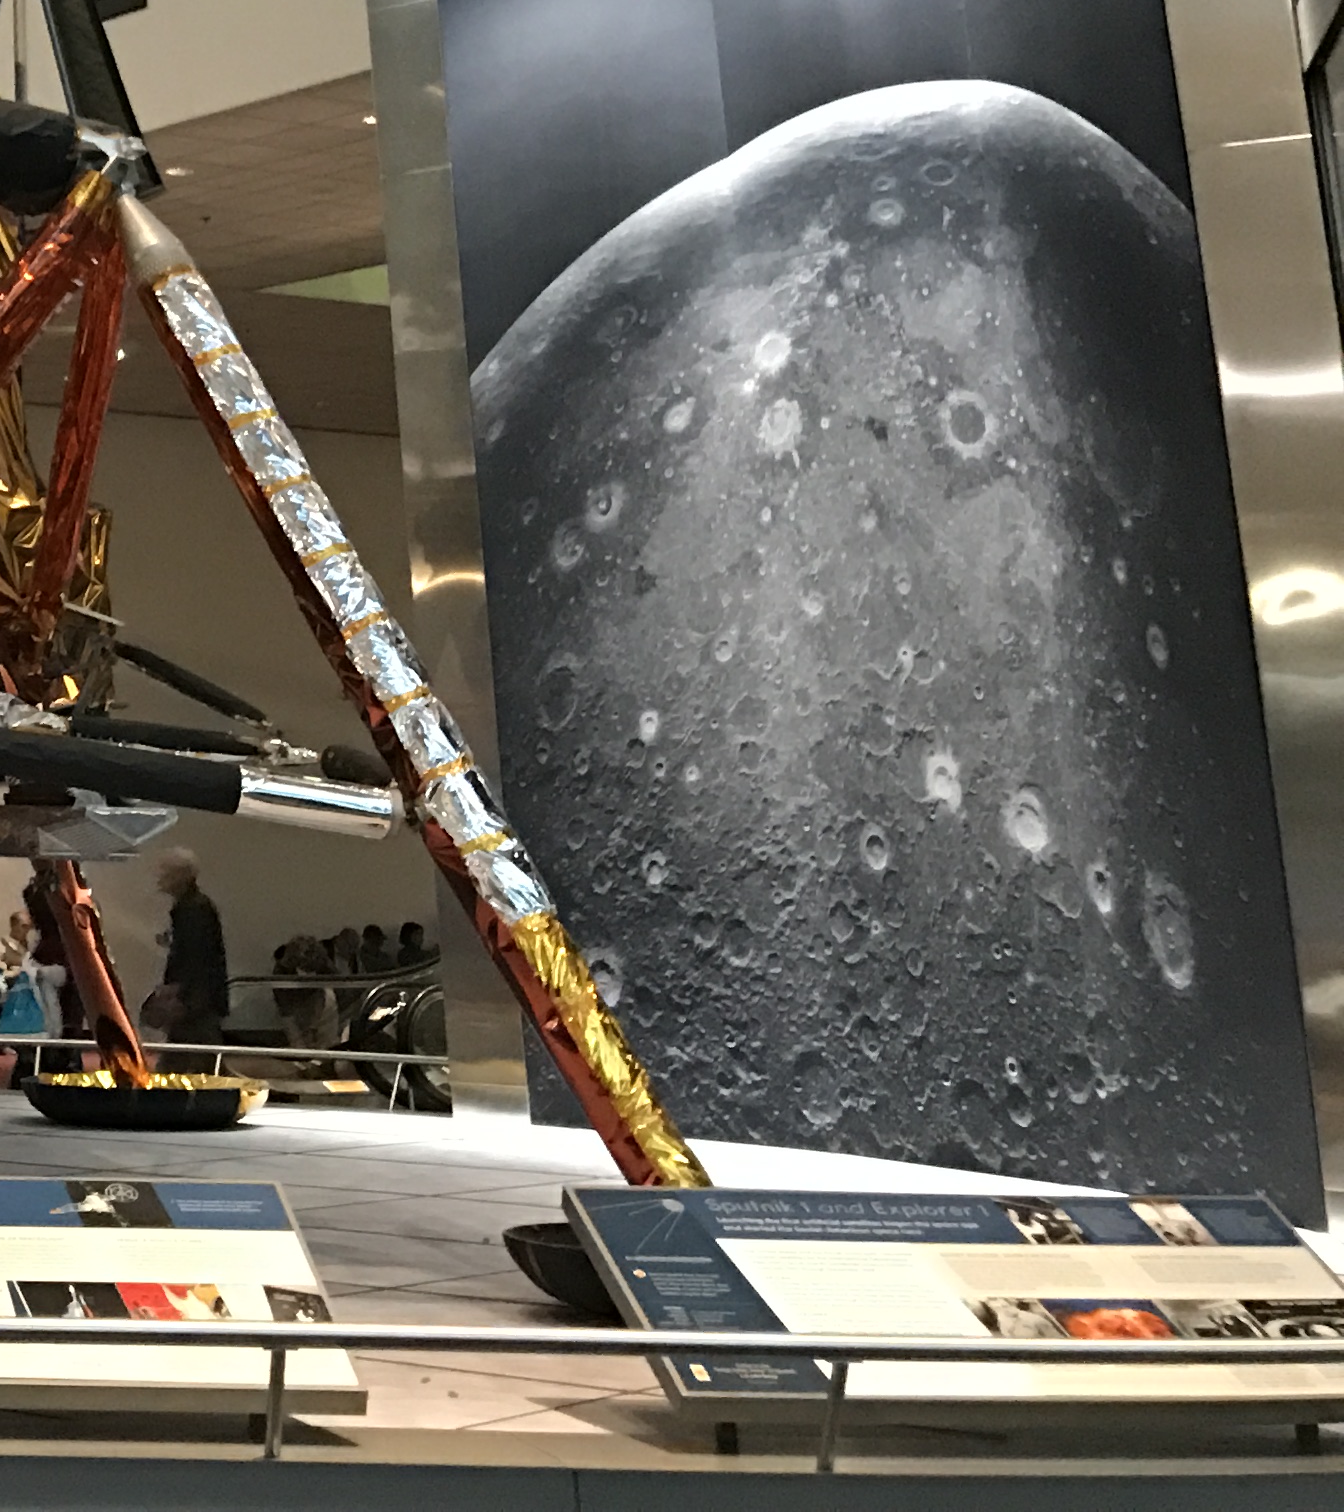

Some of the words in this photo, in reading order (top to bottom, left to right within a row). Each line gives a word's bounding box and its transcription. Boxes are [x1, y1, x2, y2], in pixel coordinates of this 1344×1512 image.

[704, 1198, 794, 1214] Sputnik
[801, 1201, 812, 1213] 1
[818, 1202, 863, 1214] and
[872, 1200, 972, 1218] Explorer
[977, 1204, 990, 1217] 1
